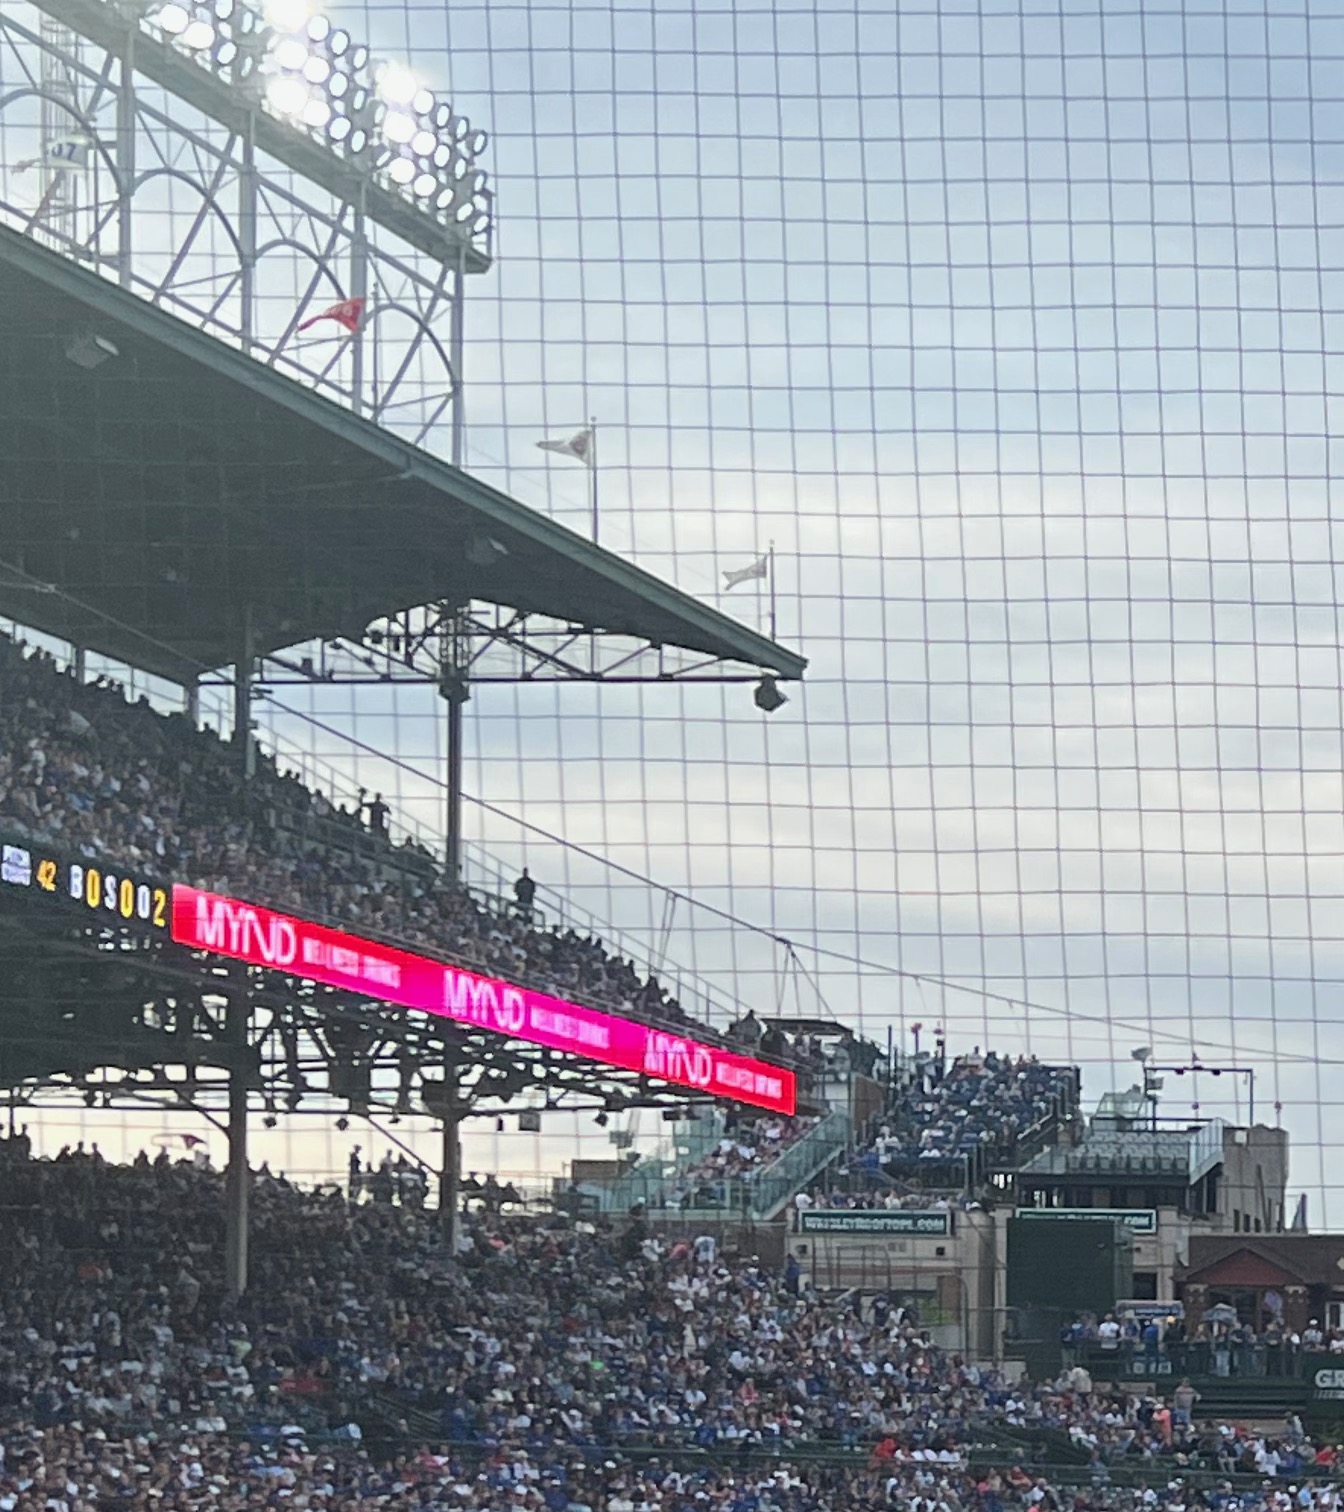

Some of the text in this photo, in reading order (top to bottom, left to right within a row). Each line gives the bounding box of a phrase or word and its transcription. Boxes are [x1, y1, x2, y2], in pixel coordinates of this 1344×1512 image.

[36, 859, 58, 892] 42
[104, 874, 117, 910] S
[153, 889, 167, 928] 2
[196, 895, 297, 967] MYND
[443, 969, 526, 1032] MYND
[644, 1032, 713, 1087] MYND
